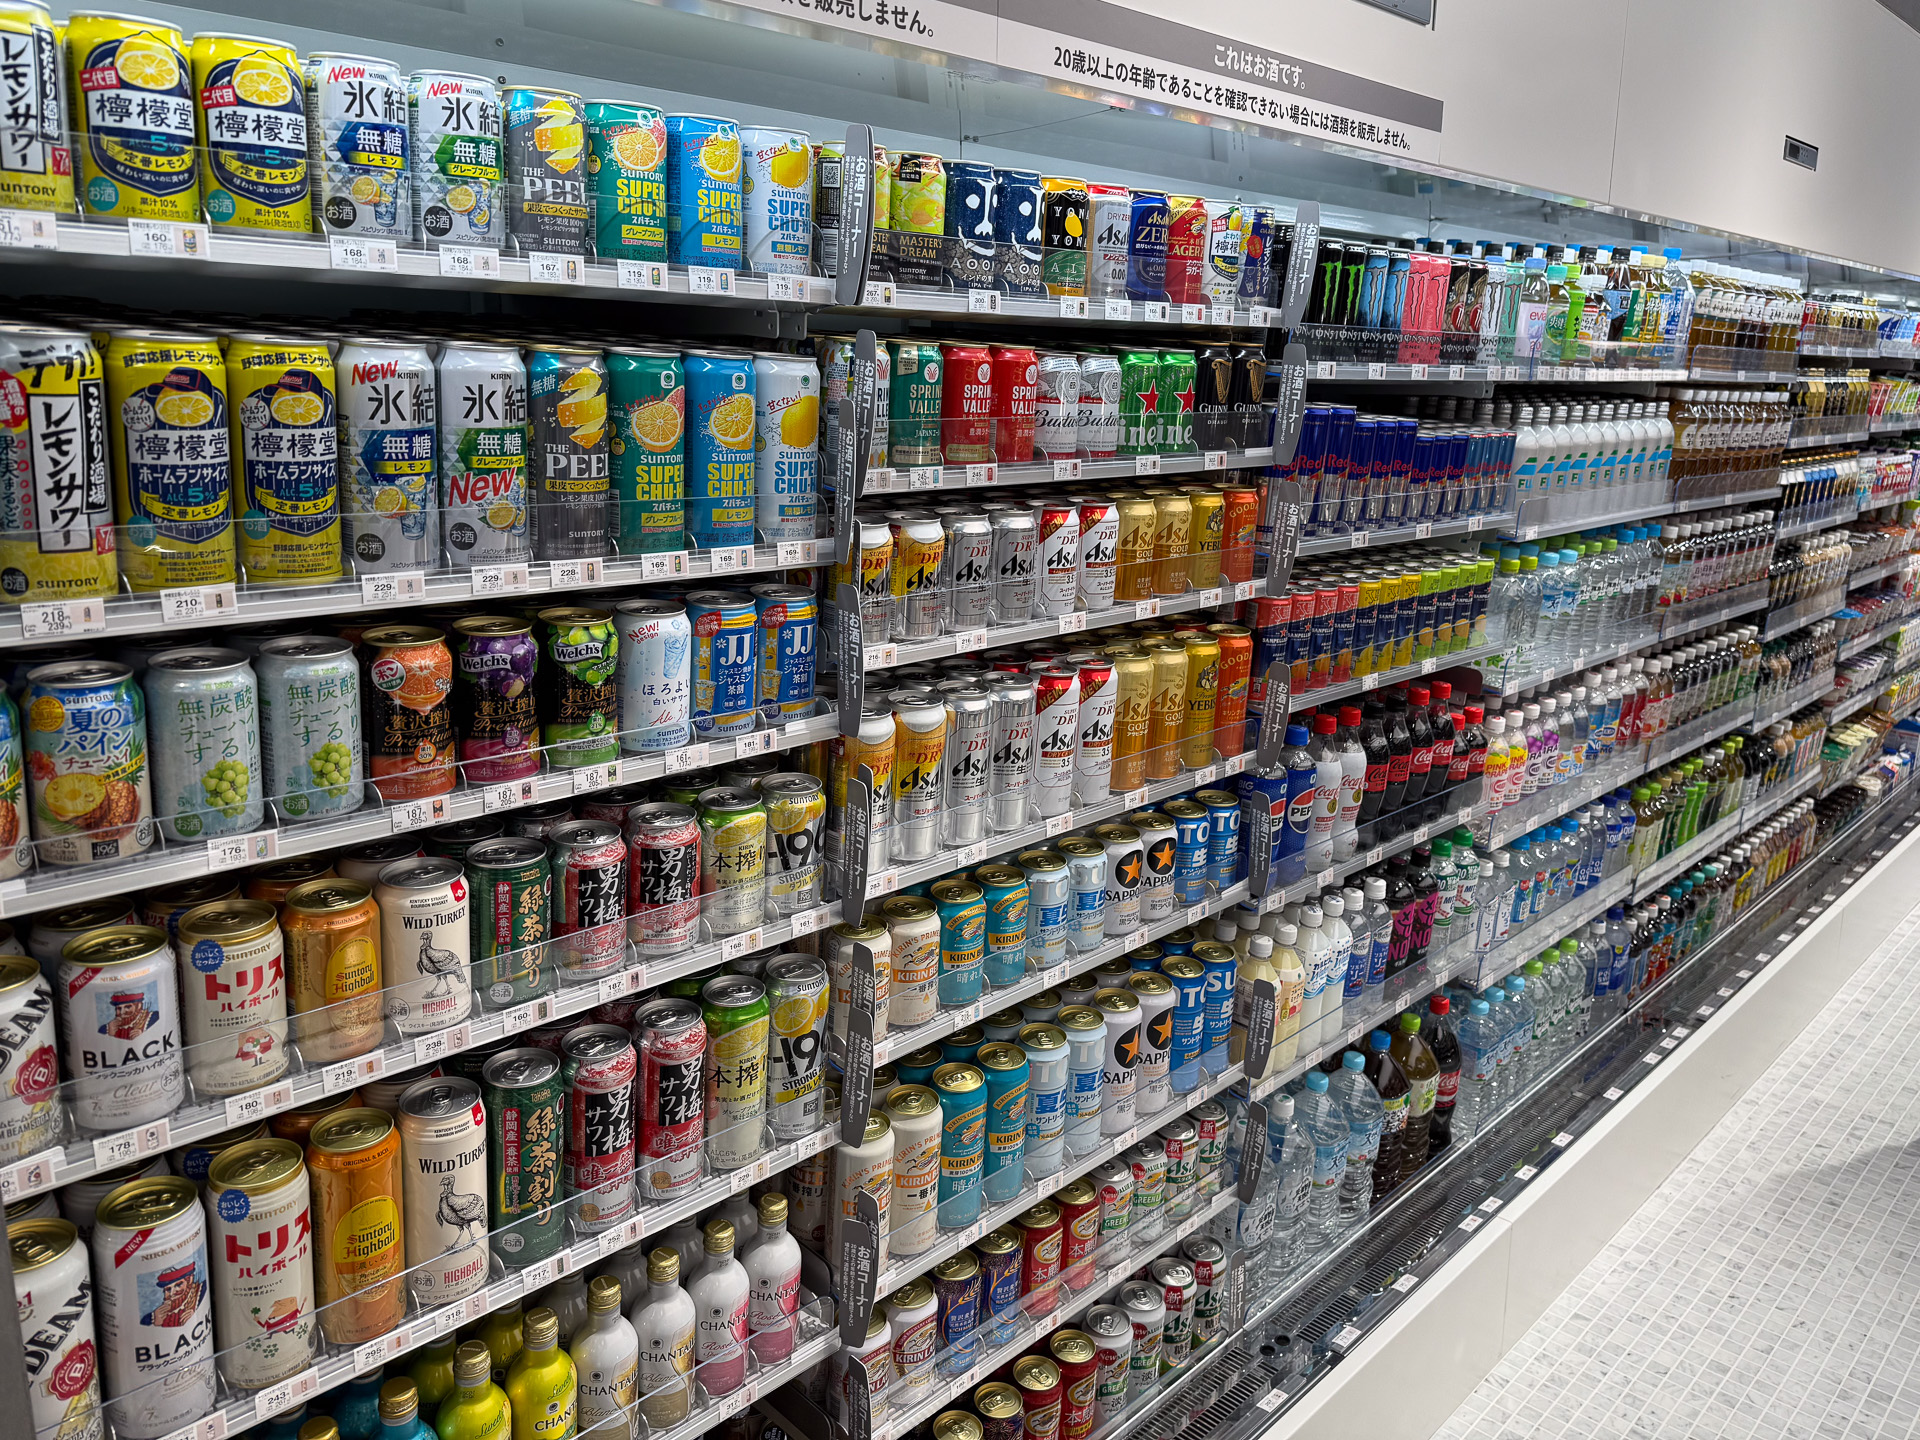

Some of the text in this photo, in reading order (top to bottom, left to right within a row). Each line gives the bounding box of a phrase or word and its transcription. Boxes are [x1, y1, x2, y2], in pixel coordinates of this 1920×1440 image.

[328, 64, 367, 84] New
[1214, 43, 1306, 90] これはお酒です。
[41, 30, 59, 138] こだわり酒場
[81, 70, 117, 89] 二代目
[202, 89, 236, 106] 二代目
[427, 80, 462, 99] New
[1054, 46, 1411, 151] 20歳以上の年齢であることを確認できない場合には酒類を販売しません。
[343, 81, 406, 124] 氷結
[95, 93, 193, 132] 檸檬堂
[441, 97, 500, 137] 氷結
[215, 110, 305, 147] 檸檬堂
[356, 127, 403, 155] 無糖
[123, 152, 186, 169] 定番レモン
[366, 156, 398, 166] レモン
[453, 142, 496, 167] 無糖
[756, 142, 789, 162] 甘くない!
[240, 166, 302, 181] 定番レモン
[451, 164, 498, 178] グレープフルーツ
[522, 167, 545, 177] THE
[88, 187, 116, 203] お酒
[617, 179, 665, 199] SUPER
[140, 198, 178, 209] 果汁10%
[208, 198, 233, 214] お酒
[698, 190, 742, 210] SUPER
[852, 156, 867, 258] お酒コーナー
[425, 215, 450, 230] お酒
[144, 233, 167, 243] 160
[714, 237, 735, 246] レモン
[899, 236, 943, 248] MASTER'S
[343, 248, 362, 258] 168
[451, 256, 469, 265] 168
[899, 247, 937, 259] DREAM
[1299, 223, 1316, 295] お酒コーナー
[541, 263, 556, 272] 167
[627, 270, 642, 278] 119
[698, 276, 714, 284] 119
[352, 360, 399, 385] New
[397, 372, 419, 380] KIRIN
[531, 374, 557, 395] 無糖
[368, 385, 436, 425] 氷結
[462, 383, 527, 423] 氷結
[766, 391, 801, 414] 甘くない!
[87, 386, 107, 507] こだわり酒場
[135, 430, 229, 461] 檸檬堂
[251, 432, 336, 460] 檸檬堂
[383, 435, 431, 459] 無糖
[477, 432, 522, 455] 無糖
[545, 443, 570, 454] THE
[394, 461, 427, 472] レモン
[475, 456, 524, 468] グレープフルーツ
[1298, 455, 1322, 469] Red
[40, 400, 82, 547] レモンサワー
[139, 466, 228, 484] ホームランサイズ
[254, 465, 336, 480] ホームランサイズ
[843, 428, 854, 522] お酒コーナー
[449, 466, 517, 507] New
[162, 503, 220, 517] 定番レモン
[275, 499, 329, 514] 定番レモン
[726, 510, 749, 520] レモン
[1282, 503, 1299, 568] お酒コーナー
[356, 540, 382, 556] お酒
[651, 561, 665, 569] 169
[719, 555, 733, 563] 169
[483, 575, 499, 584] 229
[561, 568, 577, 577] 228
[37, 577, 99, 590] SUNTORY
[374, 584, 392, 593] 229
[176, 599, 198, 610] 210
[41, 611, 65, 624] 218
[629, 622, 660, 641] New!
[637, 632, 658, 645] design
[787, 625, 814, 655] JJ
[556, 645, 601, 661] Welch's
[721, 635, 752, 665] JJ
[849, 612, 861, 698] お酒コーナー
[461, 655, 509, 671] Welch's
[727, 684, 745, 694] 茶割
[1039, 684, 1063, 711] NEW
[178, 688, 253, 724] 無炭酸
[1273, 683, 1288, 743] お酒コーナー
[65, 705, 122, 735] 夏の
[57, 728, 132, 756] パイン
[61, 748, 131, 771] チューハイ
[283, 797, 309, 812] お酒
[498, 791, 513, 801] 187
[221, 847, 242, 857] 176
[738, 844, 757, 852] KIRIN
[640, 855, 657, 905] サワー
[659, 847, 685, 905] 男梅
[402, 905, 466, 930] WILD TURKEY
[496, 883, 511, 944] 静岡産一番茶使用
[518, 884, 545, 989] 緑茶割り
[74, 970, 95, 988] NEW
[205, 956, 284, 1001] トリス
[332, 971, 375, 994] Highball
[220, 986, 279, 1012] ハイボール
[422, 996, 457, 1012] HIGHBALL
[83, 1031, 175, 1068] BLACK
[858, 1036, 872, 1115] お酒コーナー
[239, 1100, 258, 1112] 180
[604, 1084, 632, 1154] 男梅
[585, 1106, 606, 1157] サワー
[109, 1144, 129, 1155] 178
[505, 1109, 520, 1174] 静岡産一番茶使用
[525, 1107, 556, 1225] 緑茶割り
[900, 1175, 930, 1188] KIRIN
[225, 1206, 311, 1264] トリス
[238, 1245, 309, 1279] ハイボール
[856, 1246, 871, 1318] お酒コーナー
[267, 1393, 286, 1404] 243
